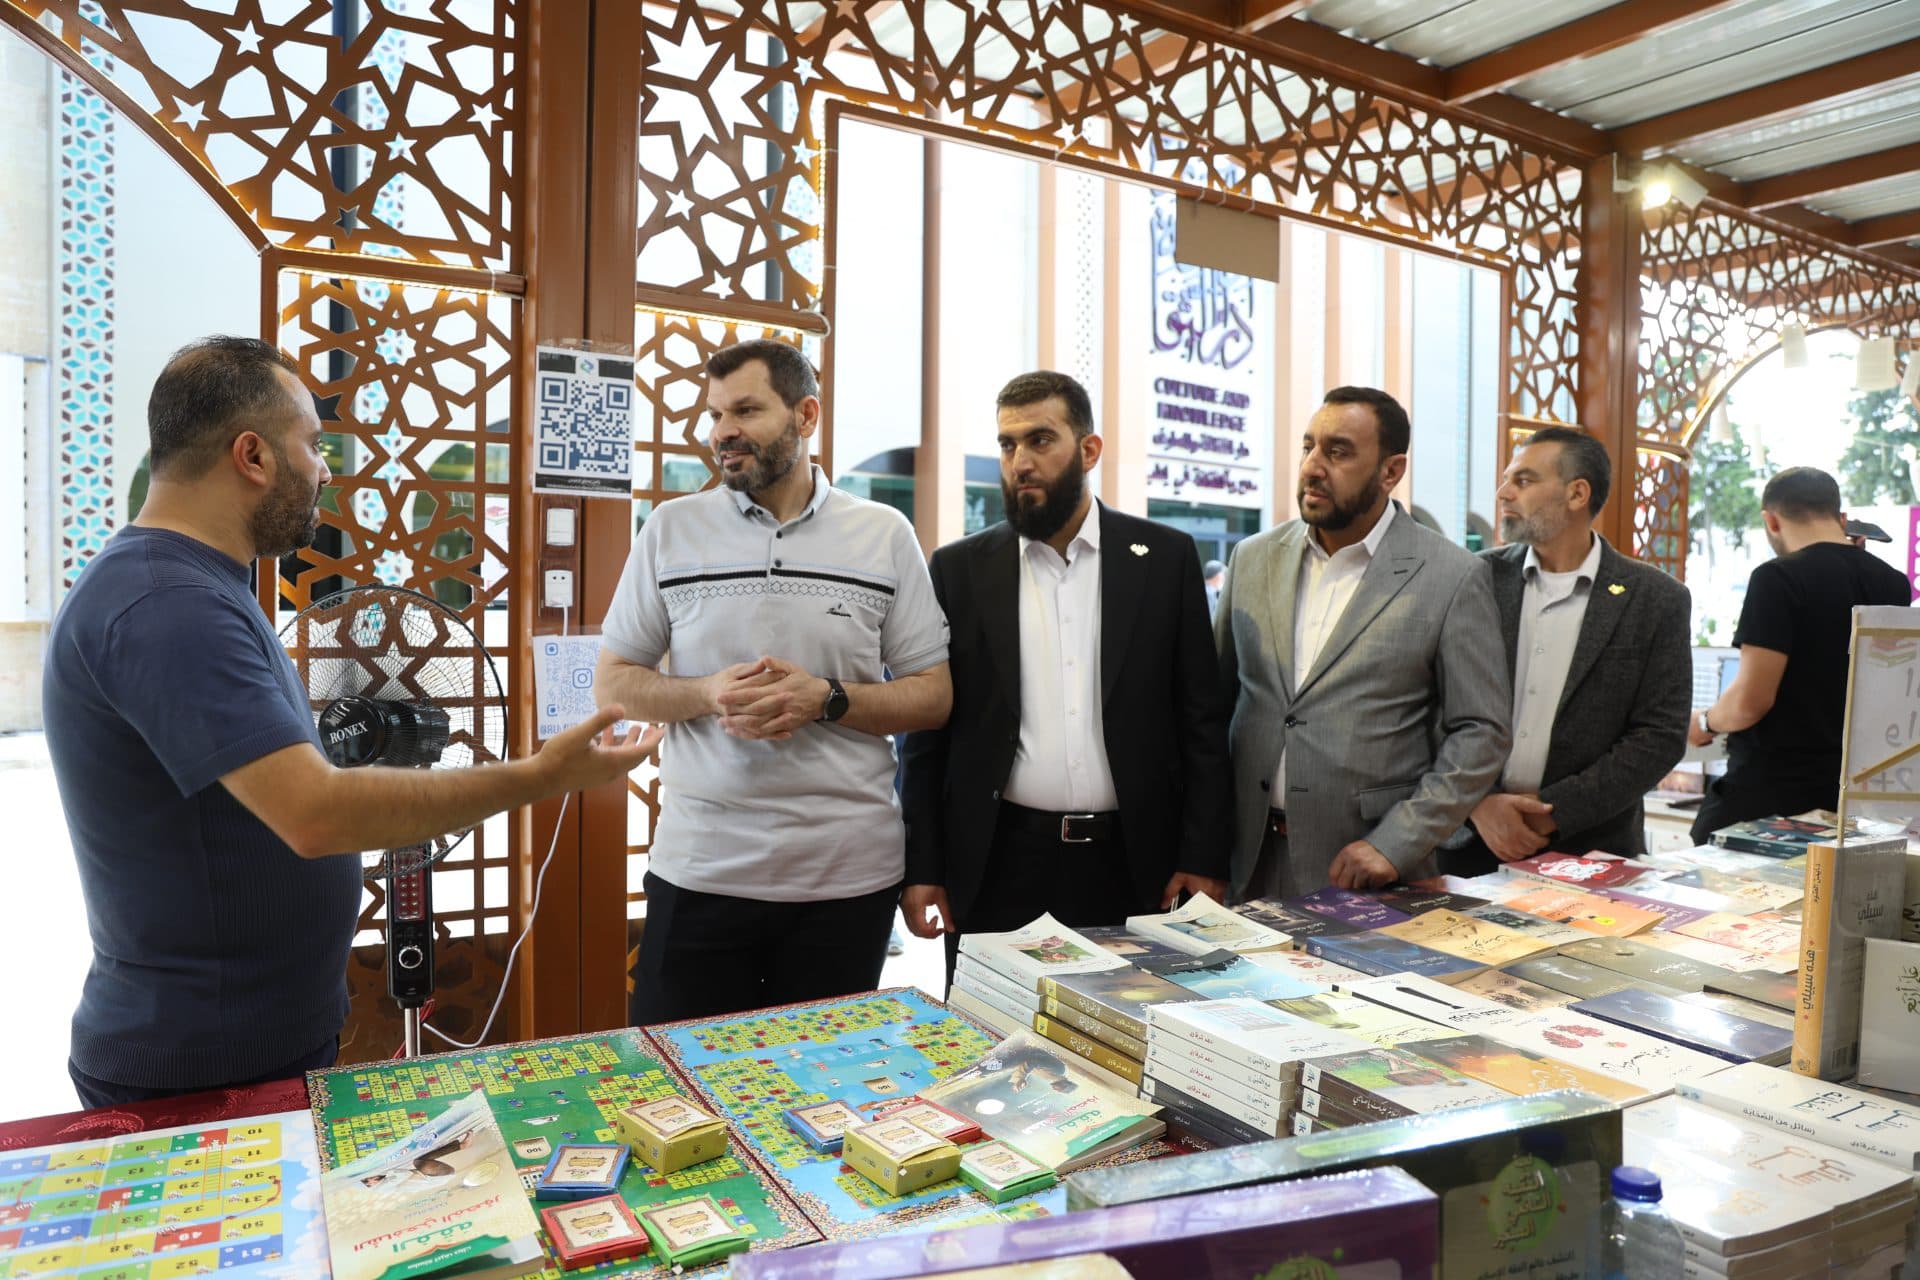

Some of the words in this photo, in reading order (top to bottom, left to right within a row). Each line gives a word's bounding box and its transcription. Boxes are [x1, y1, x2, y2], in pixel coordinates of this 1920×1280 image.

[1154, 377, 1218, 403] CULTURE
[1221, 391, 1250, 408] AND
[329, 721, 368, 744] RONEX
[1807, 950, 1815, 973] هذه
[1804, 974, 1815, 1010] سبيلي
[1776, 1118, 1788, 1126] من
[247, 1127, 263, 1135] 10
[1790, 1124, 1815, 1135] رسائل
[526, 1147, 542, 1155] 100
[183, 1158, 201, 1167] 12
[127, 1168, 145, 1176] 13
[244, 1171, 265, 1180] 30
[178, 1181, 200, 1191] 29
[56, 1200, 79, 1209] 27
[243, 1195, 263, 1205] 31
[183, 1205, 205, 1214] 32
[121, 1215, 144, 1224] 33
[242, 1220, 264, 1230] 50
[47, 1226, 72, 1236] 34
[179, 1231, 203, 1241] 49
[240, 1248, 263, 1259] 51
[37, 1255, 62, 1264] 47
[175, 1259, 199, 1269] 52
[407, 1259, 432, 1270] سلسلة
